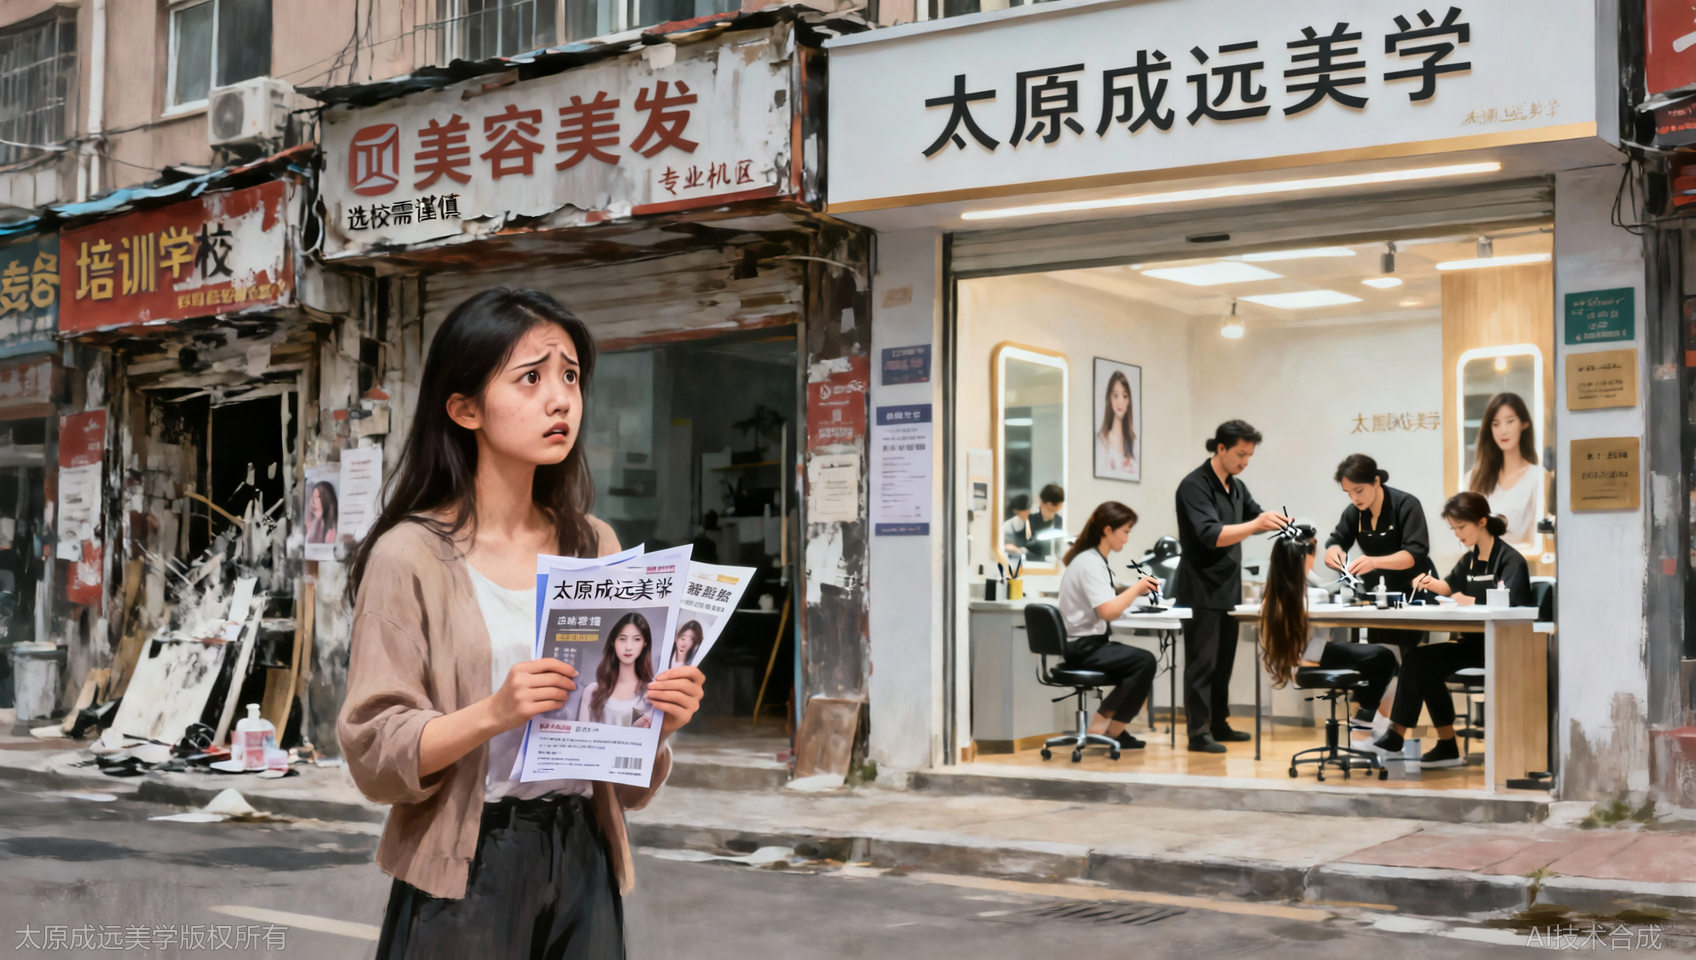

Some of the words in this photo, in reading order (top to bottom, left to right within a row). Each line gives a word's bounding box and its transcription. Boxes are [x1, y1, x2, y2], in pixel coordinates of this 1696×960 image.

[921, 6, 1472, 158] 太原成远美学
[413, 79, 700, 191] 美容美发
[658, 159, 755, 196] 专业机区
[75, 222, 234, 301] 培训学校
